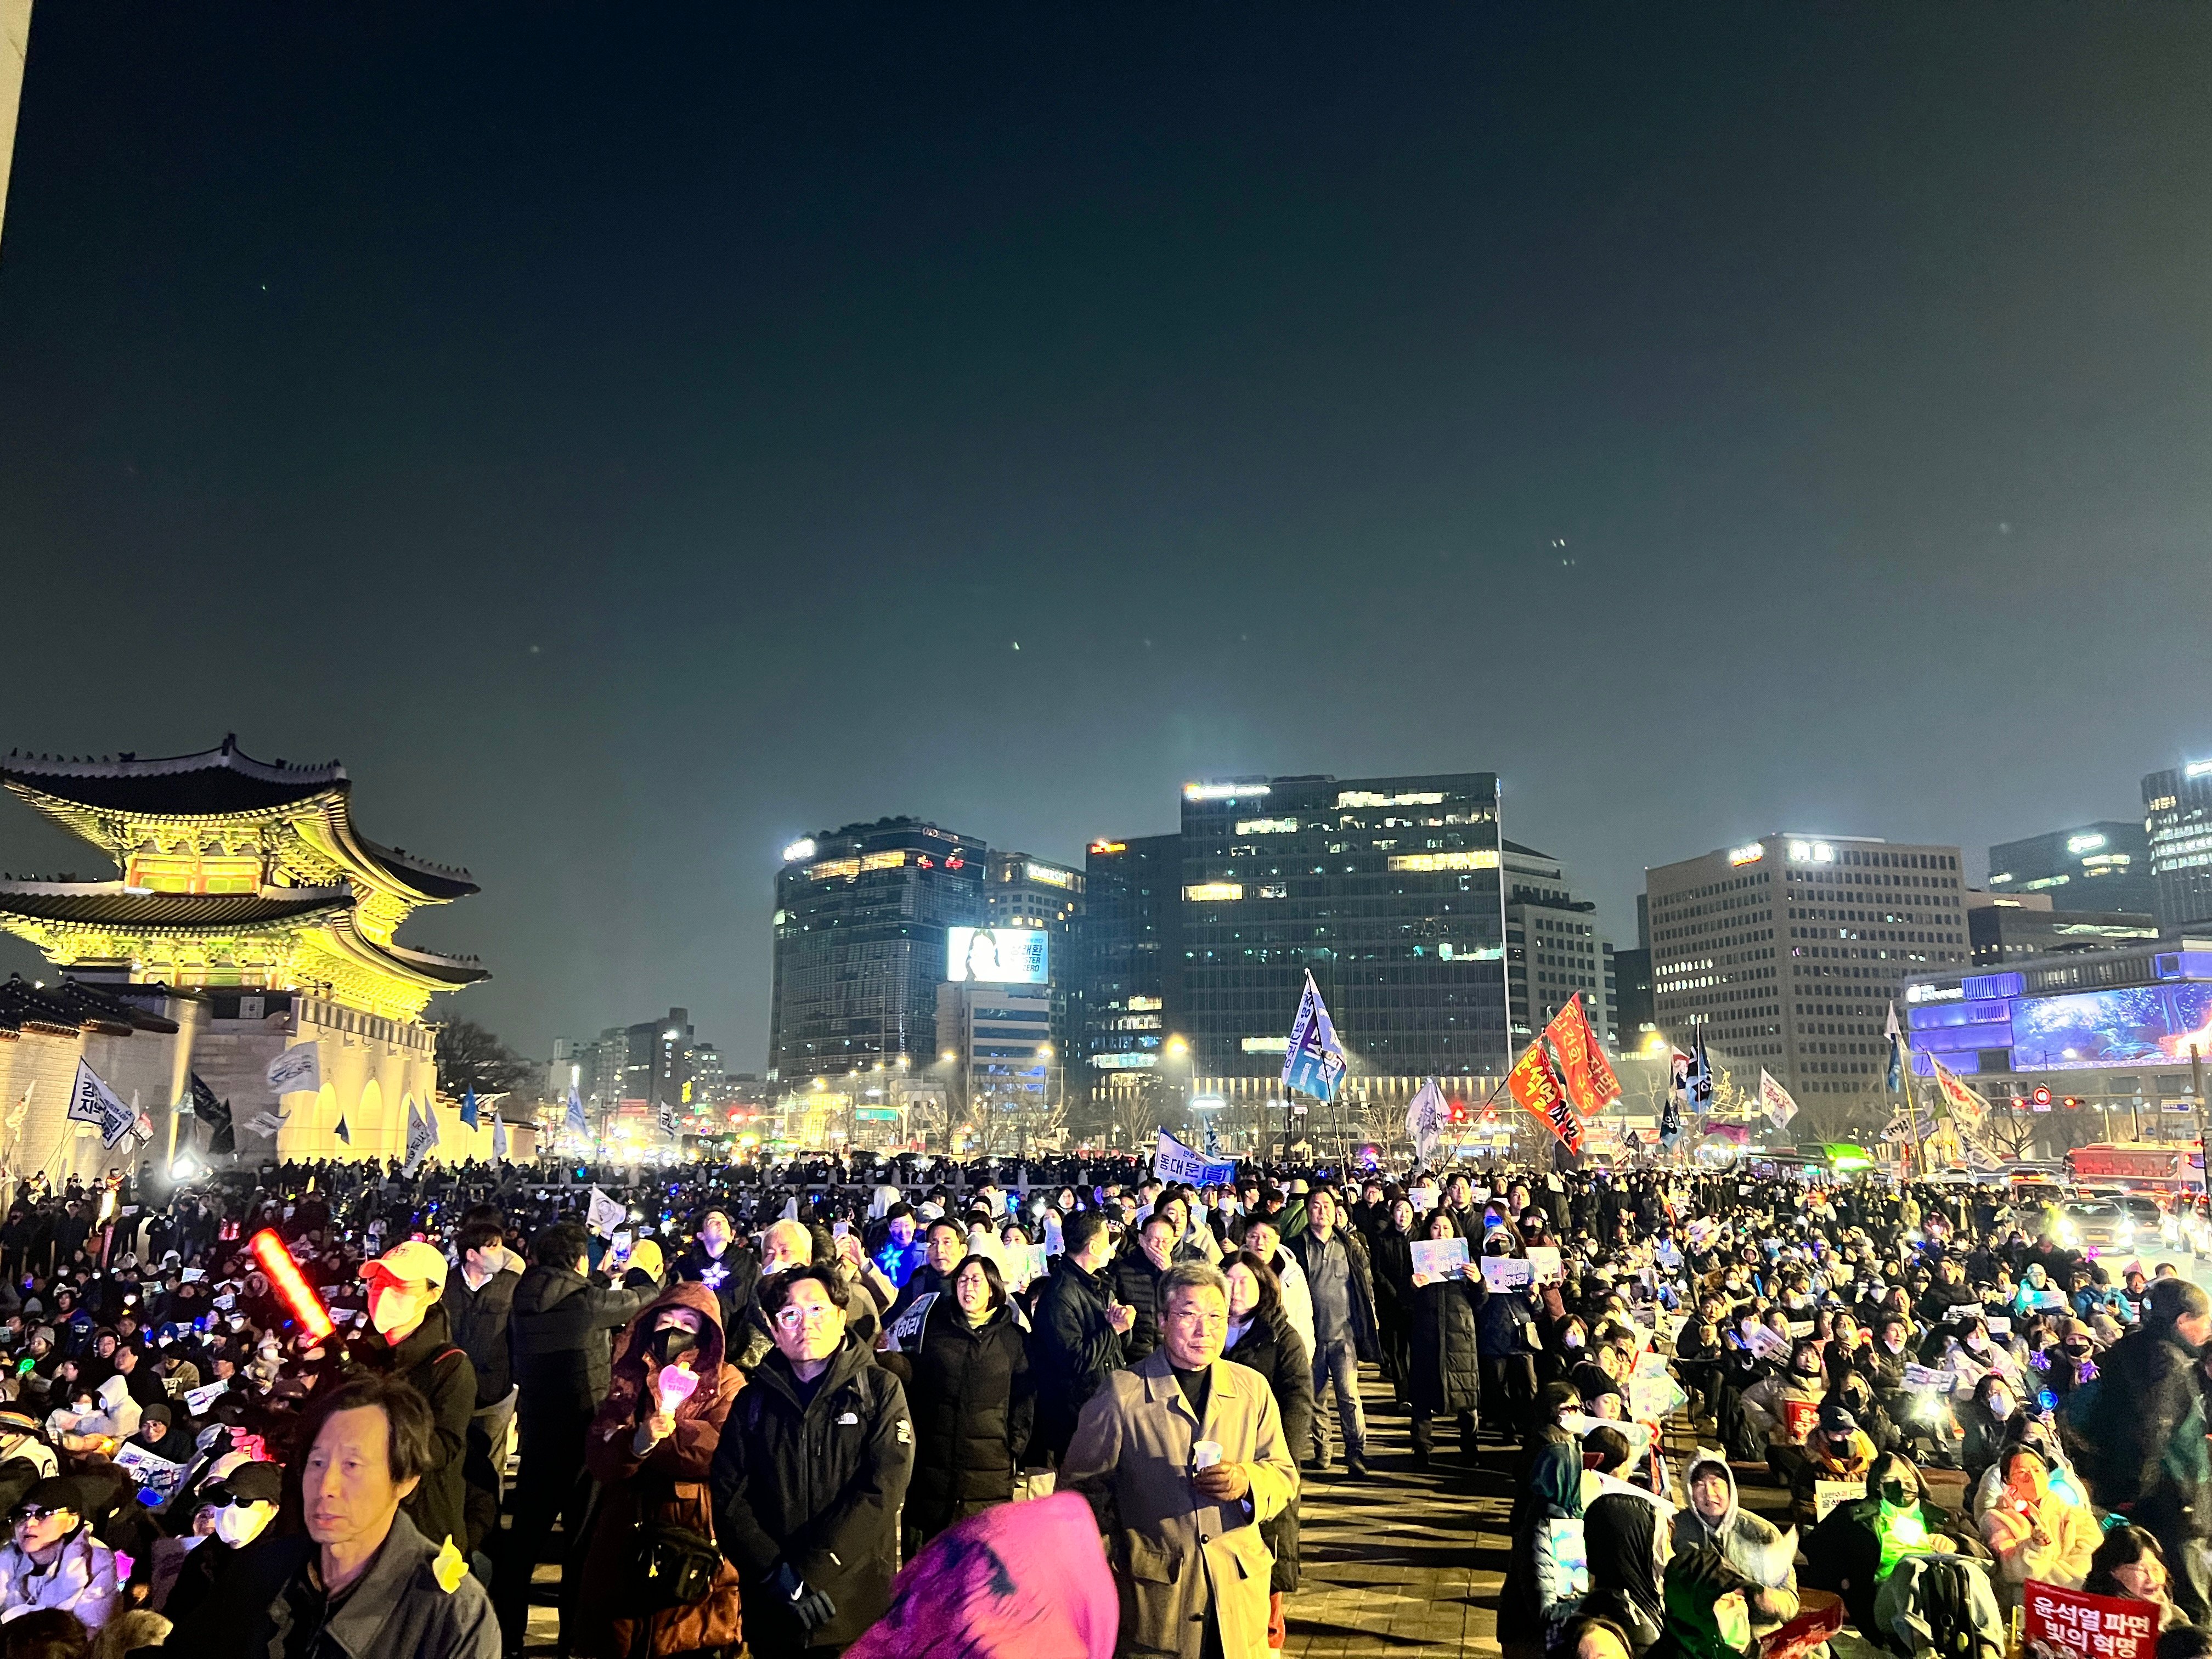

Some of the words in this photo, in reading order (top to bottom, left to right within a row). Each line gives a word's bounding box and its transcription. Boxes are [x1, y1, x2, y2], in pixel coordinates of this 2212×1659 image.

[1515, 1048, 1559, 1113] 윤석열
[1504, 1273, 1530, 1286] 하라
[2032, 1596, 2100, 1633] 윤석열
[2103, 1612, 2151, 1639] 파면
[2044, 1619, 2089, 1652] 빛의
[2092, 1633, 2138, 1659] 혁명
